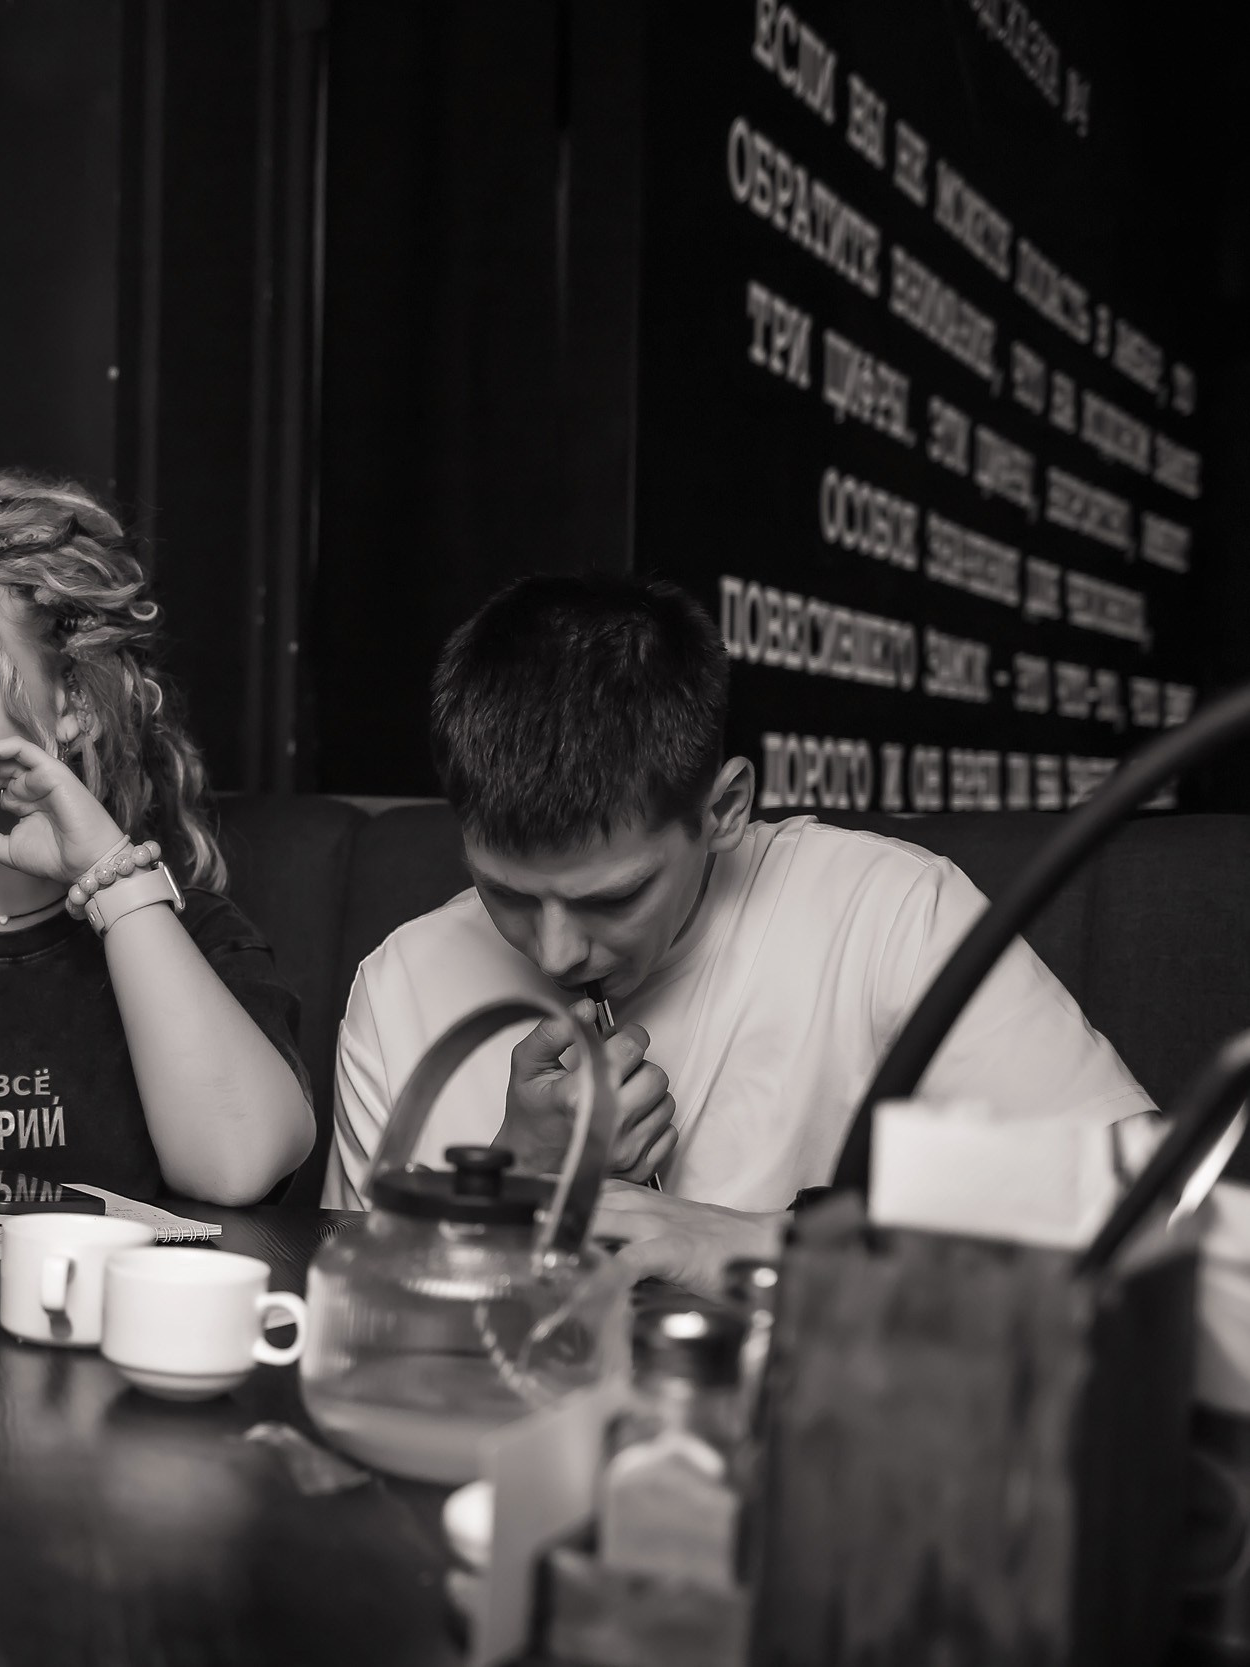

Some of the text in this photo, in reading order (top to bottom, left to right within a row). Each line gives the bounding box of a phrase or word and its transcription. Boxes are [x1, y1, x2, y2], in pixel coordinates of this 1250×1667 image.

[752, 0, 837, 124] ЕСЛИ
[727, 116, 881, 297] ОБРАТИТЕ
[747, 280, 812, 389] ТРИ
[820, 467, 919, 571] ОСОБОЕ
[759, 732, 873, 812] ДОРОГО
